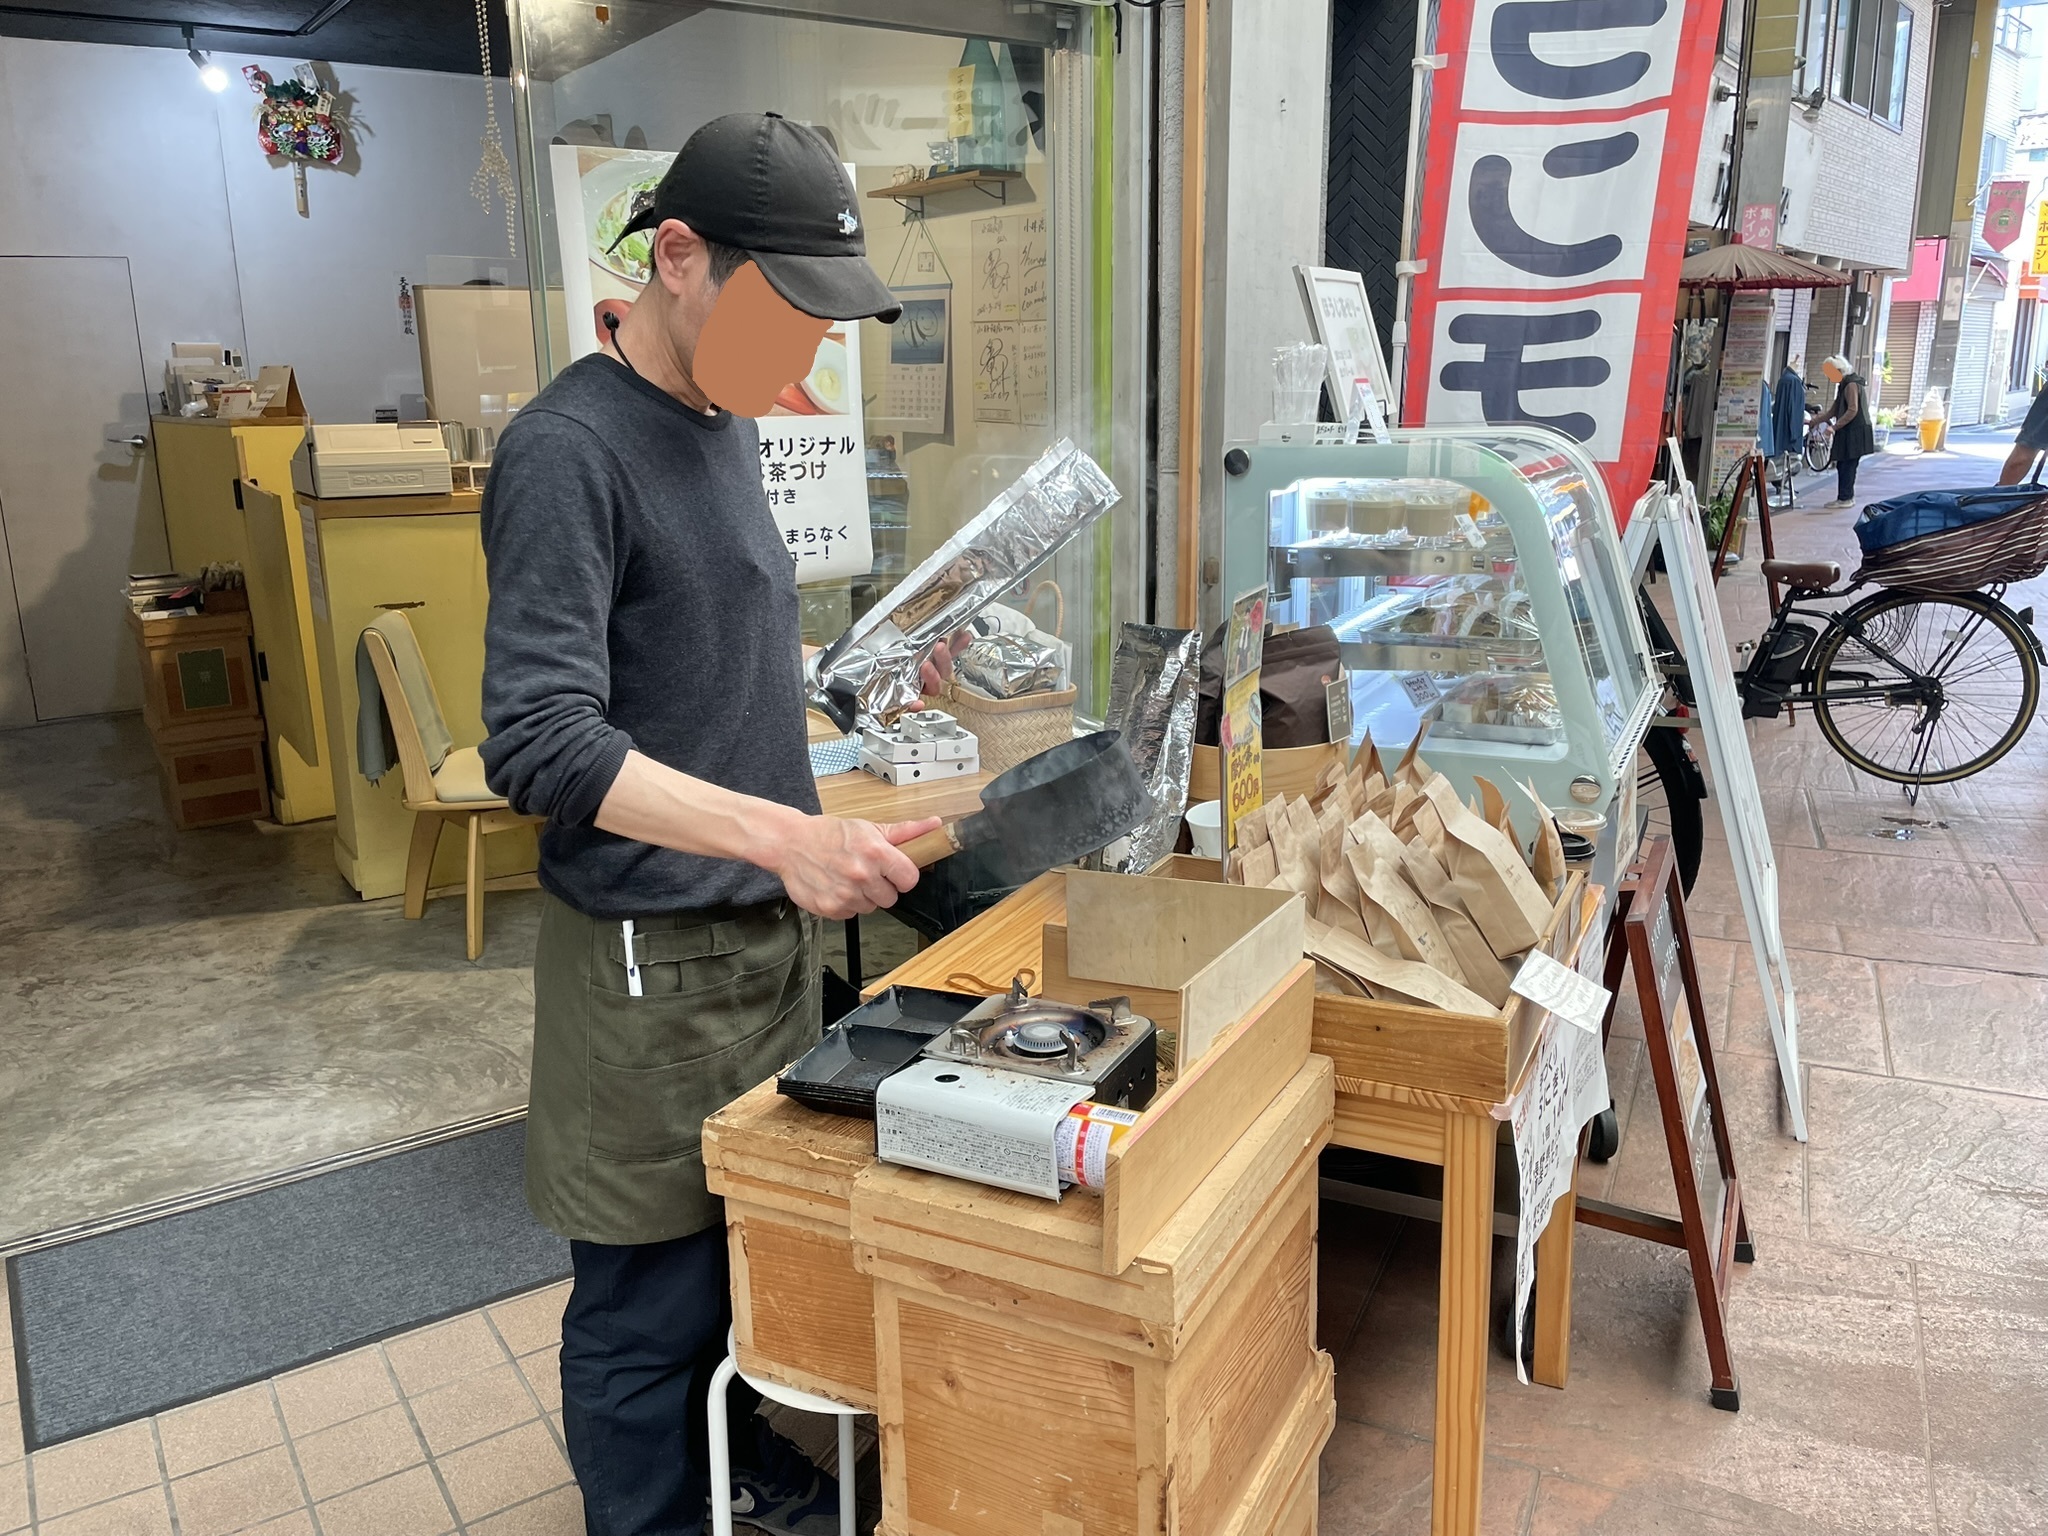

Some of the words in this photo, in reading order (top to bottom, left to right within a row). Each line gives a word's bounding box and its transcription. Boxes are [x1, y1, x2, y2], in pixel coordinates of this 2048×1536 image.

[759, 436, 856, 458] オリジナル
[352, 472, 420, 487] SHARP
[785, 525, 849, 545] まらなく
